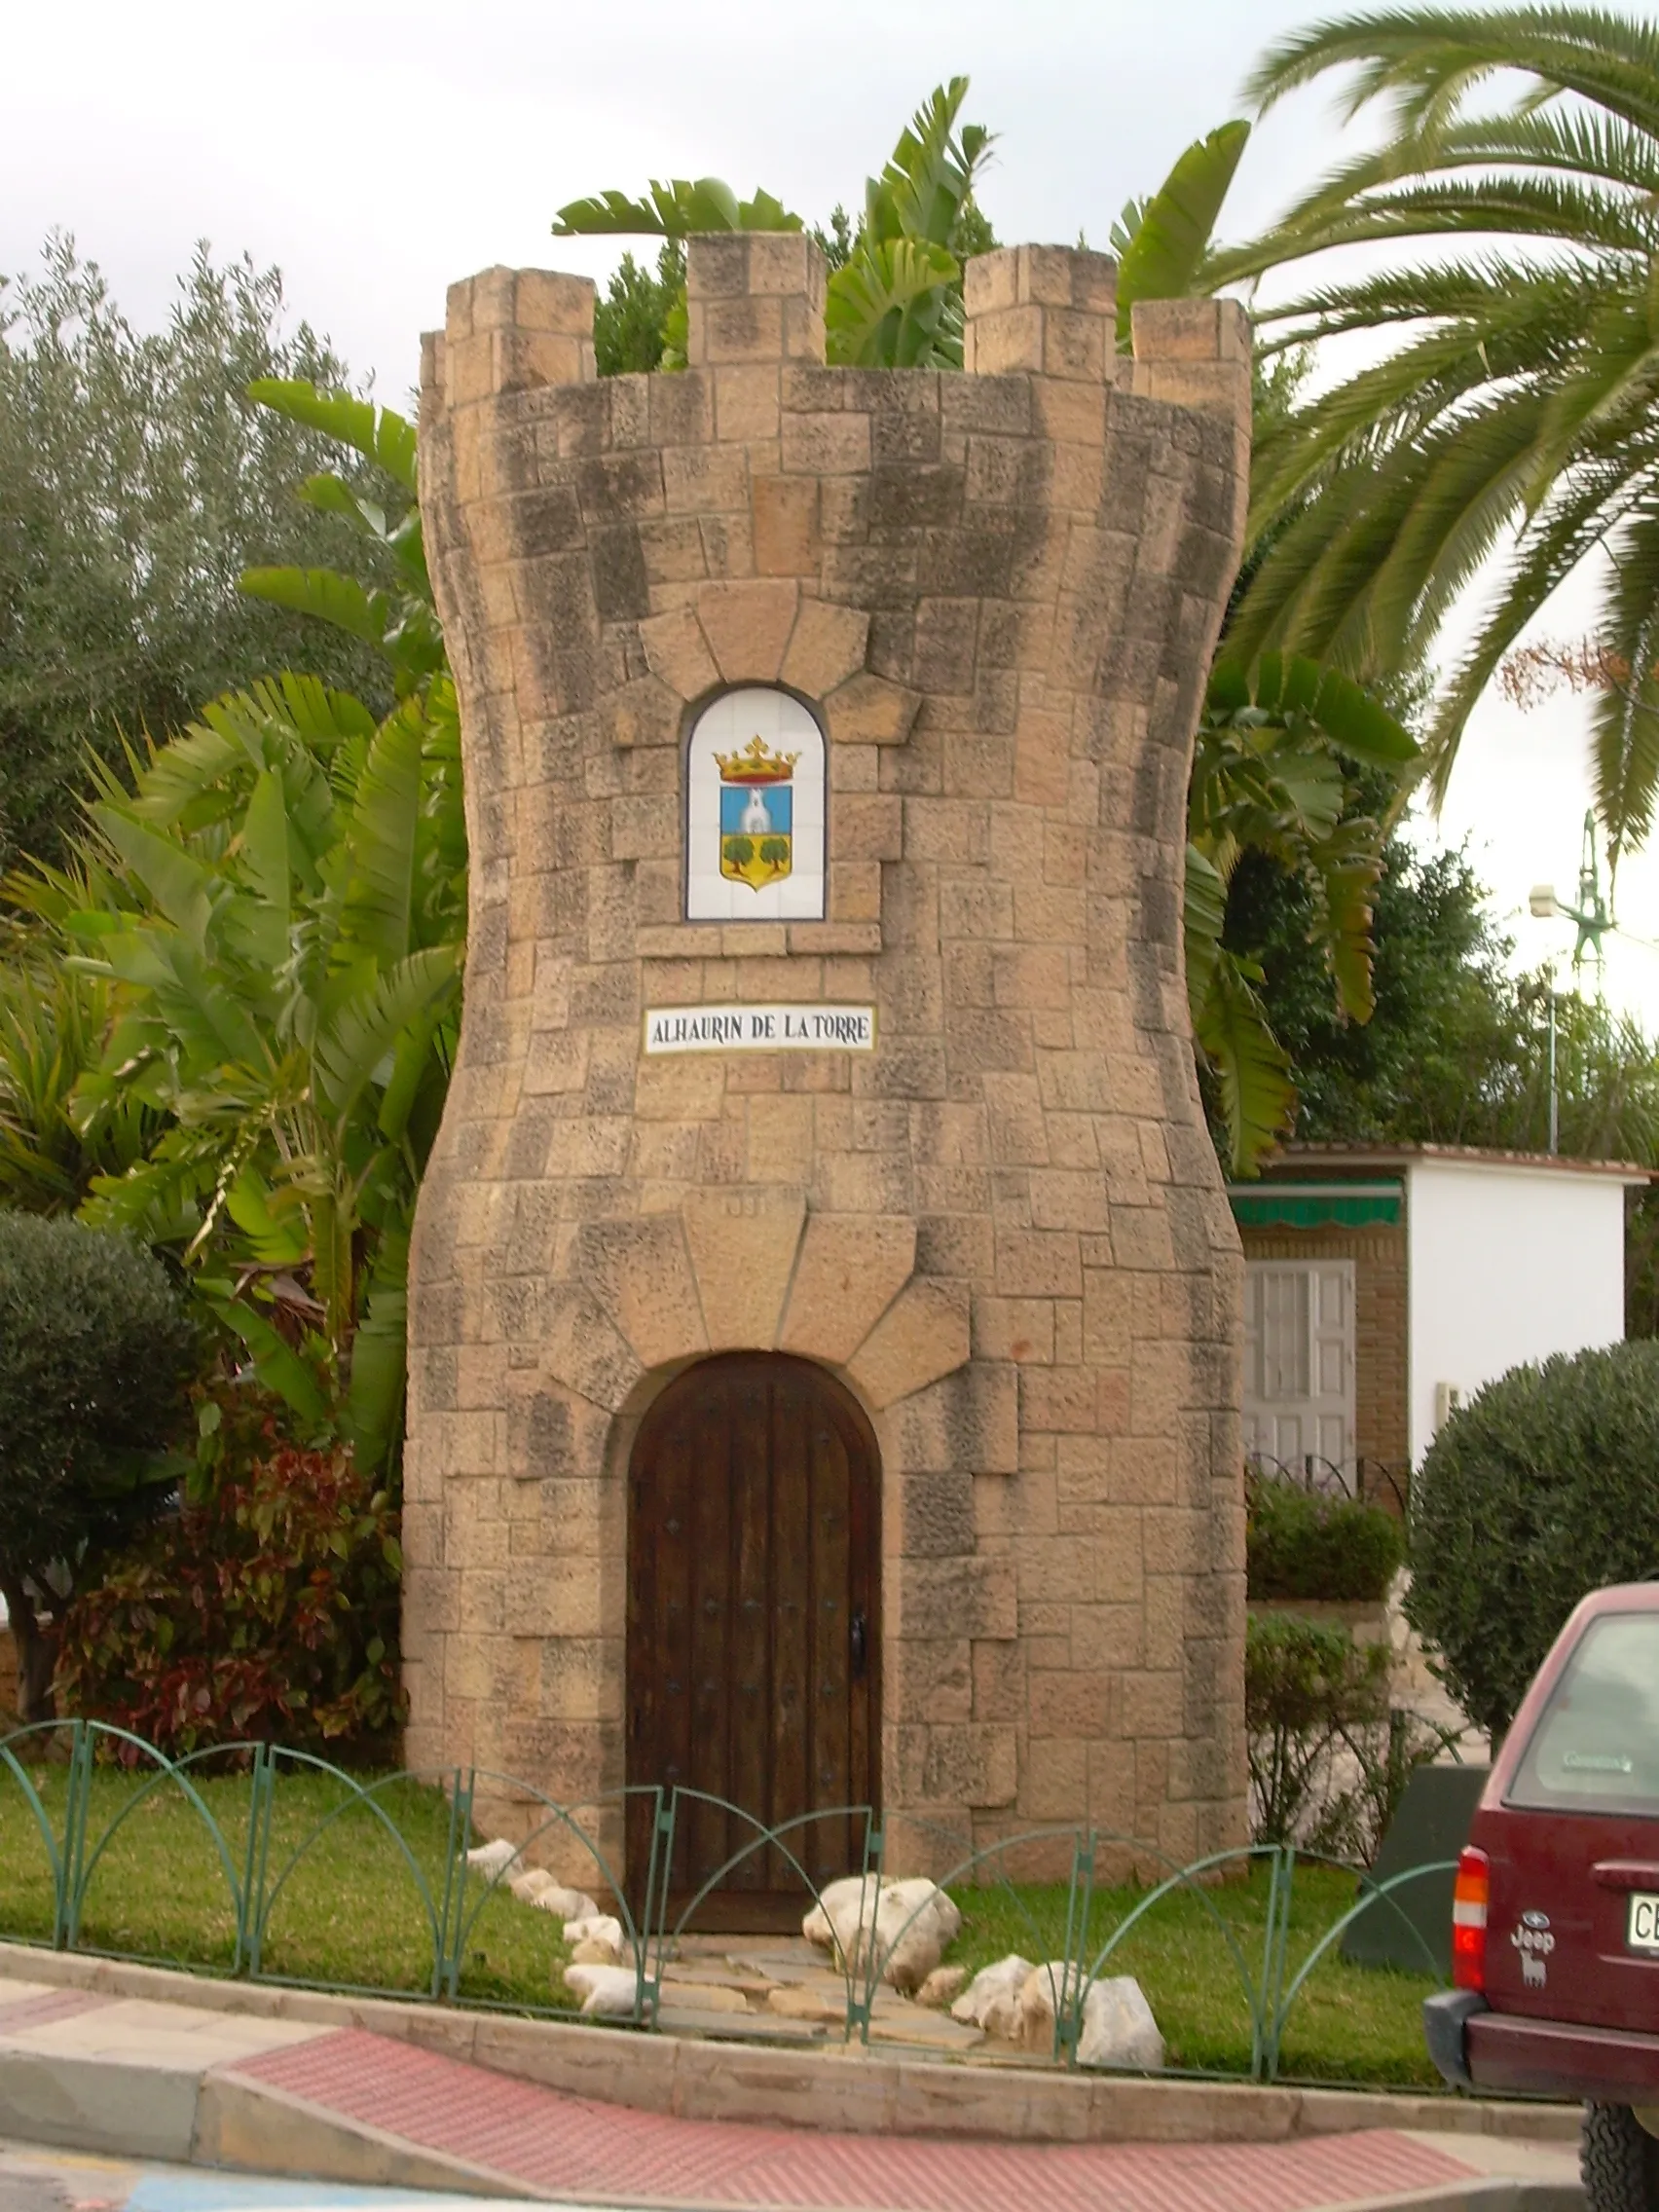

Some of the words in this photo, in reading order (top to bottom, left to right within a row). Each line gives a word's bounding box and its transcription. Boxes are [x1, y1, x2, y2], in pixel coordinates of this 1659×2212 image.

[652, 1015, 742, 1045] ALHAURIN
[752, 1014, 776, 1039] DE
[784, 1014, 810, 1039] LA
[812, 1014, 870, 1045] TORRE
[1509, 1923, 1556, 1956] Jeep
